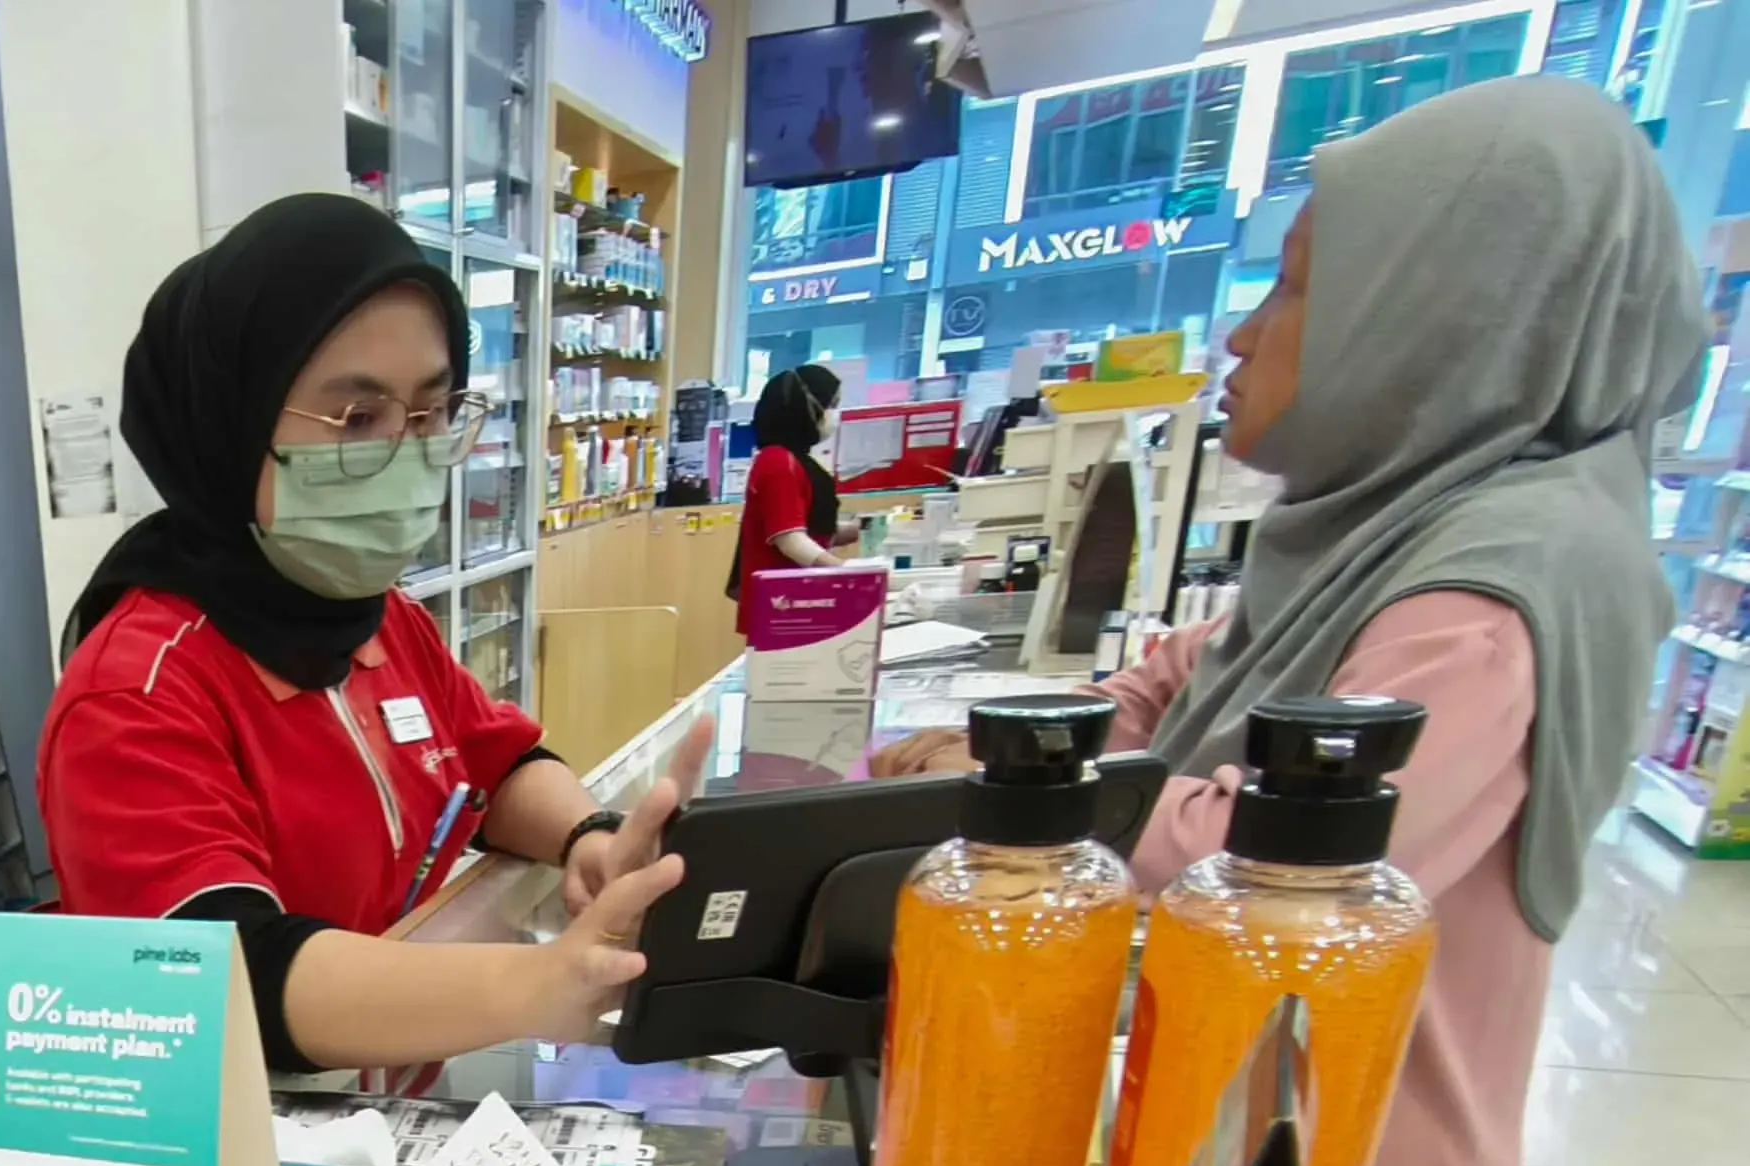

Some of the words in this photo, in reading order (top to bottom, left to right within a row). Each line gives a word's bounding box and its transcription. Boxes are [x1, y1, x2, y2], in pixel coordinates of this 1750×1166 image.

[978, 216, 1192, 273] MAXGLOW
[784, 276, 837, 301] DRY
[133, 946, 165, 963] pine
[168, 948, 202, 963] labs
[8, 982, 64, 1024] 0%
[65, 1002, 197, 1034] instalment
[5, 1030, 107, 1054] payment
